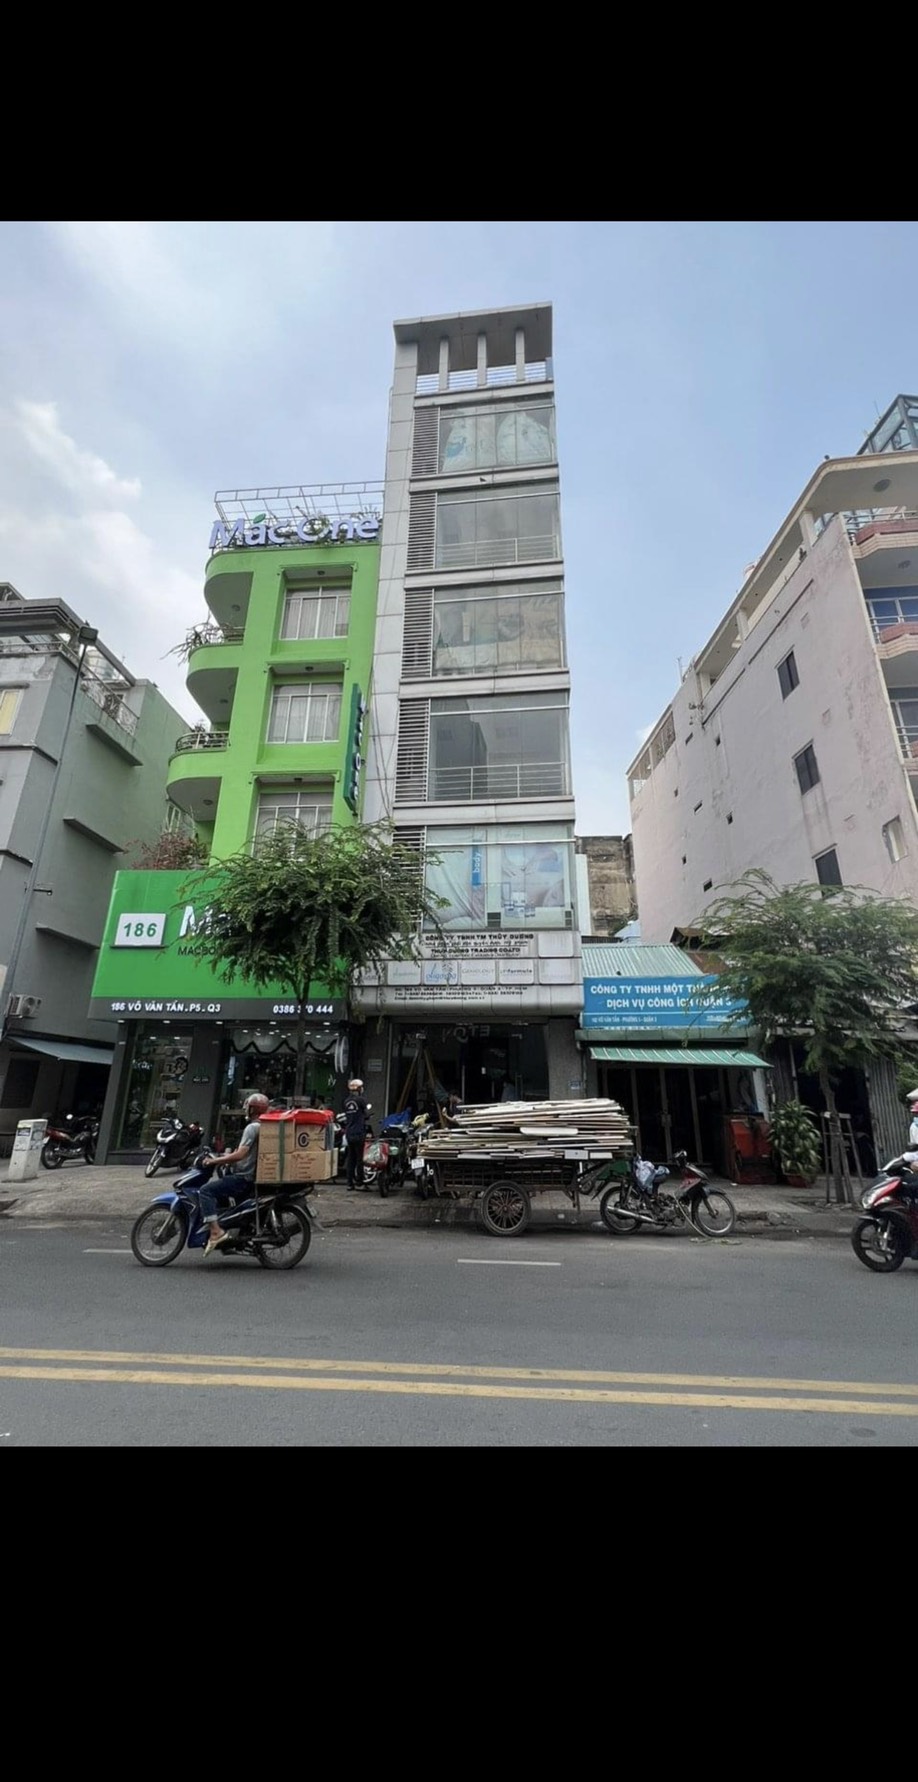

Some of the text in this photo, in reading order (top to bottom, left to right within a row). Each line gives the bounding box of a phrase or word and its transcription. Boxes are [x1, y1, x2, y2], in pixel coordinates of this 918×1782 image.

[472, 852, 482, 873] body
[123, 922, 158, 938] 186
[590, 983, 618, 994] CÔNG
[619, 985, 632, 994] TY
[634, 985, 661, 994] TNHH
[663, 983, 684, 996] MỘT
[111, 1001, 126, 1011] 186
[144, 1000, 164, 1012] VĂN
[272, 1004, 295, 1014] 0386
[315, 1004, 333, 1014] 444
[606, 999, 630, 1011] DỊCH
[631, 999, 645, 1011] VỤ
[646, 997, 675, 1008] CÔNG
